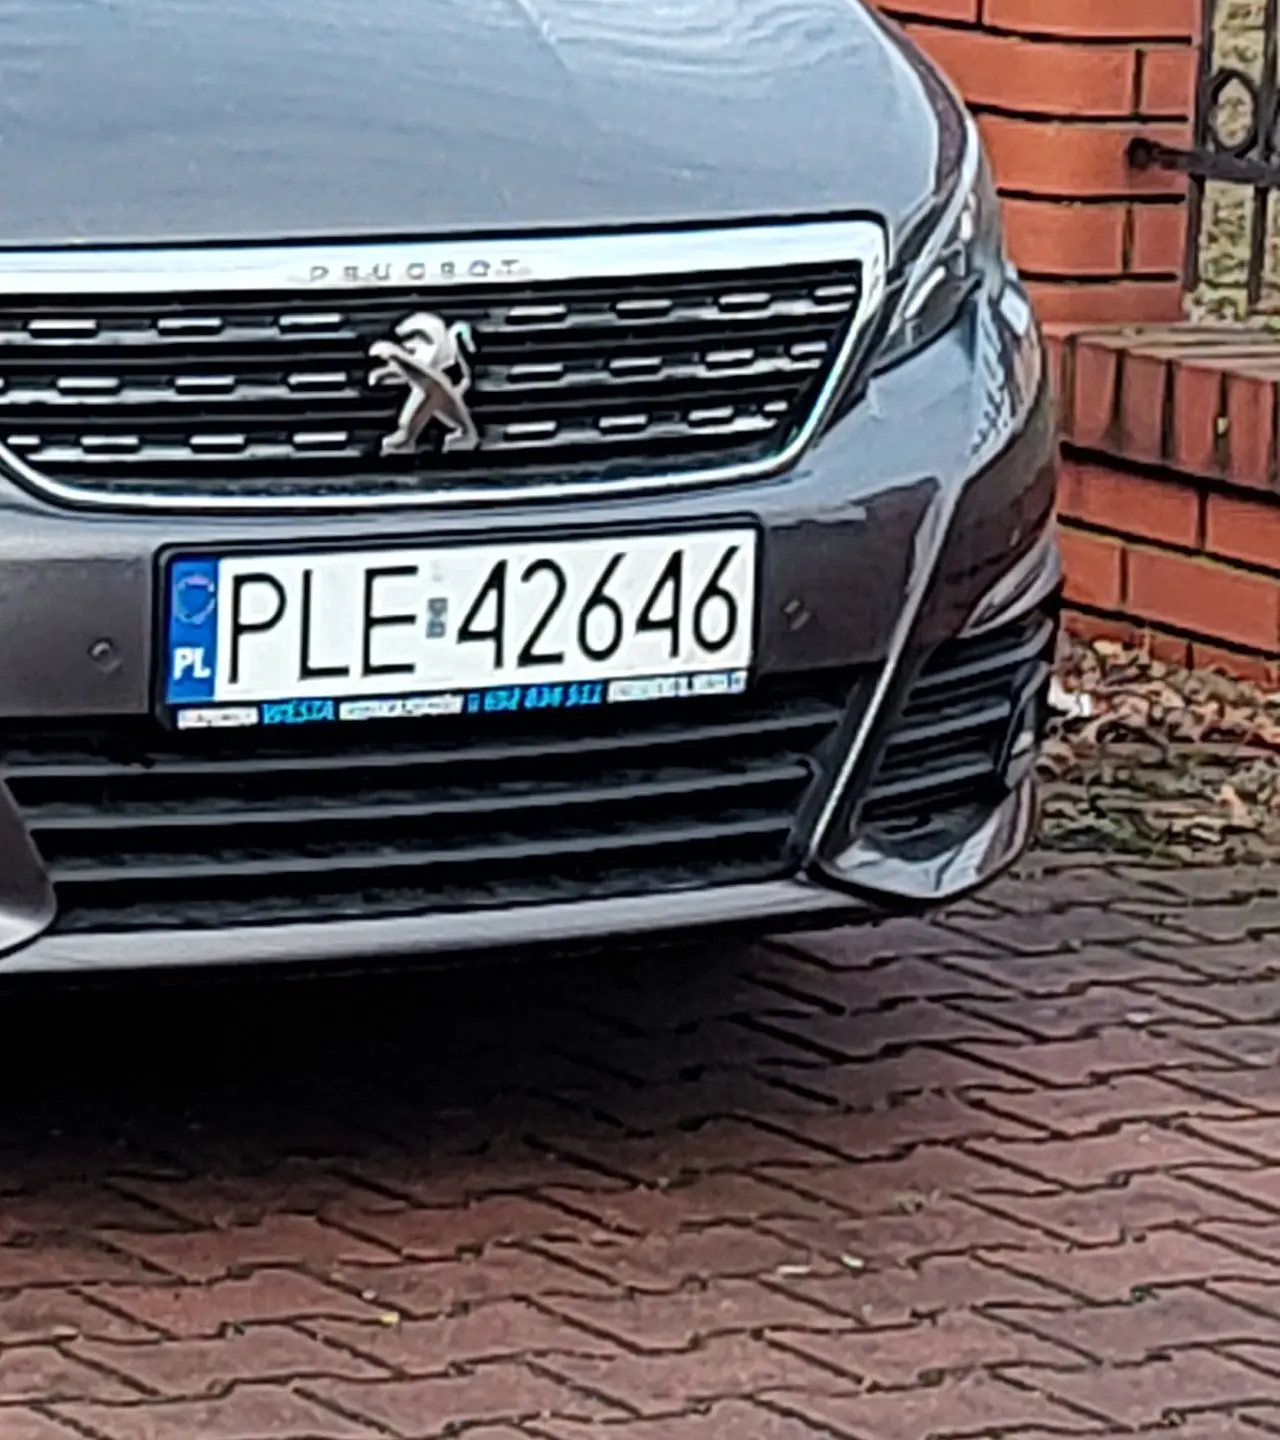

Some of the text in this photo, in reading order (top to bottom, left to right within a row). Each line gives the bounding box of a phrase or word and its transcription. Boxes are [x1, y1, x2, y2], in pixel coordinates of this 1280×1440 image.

[228, 544, 741, 685] PLE 42646
[172, 646, 211, 681] PL
